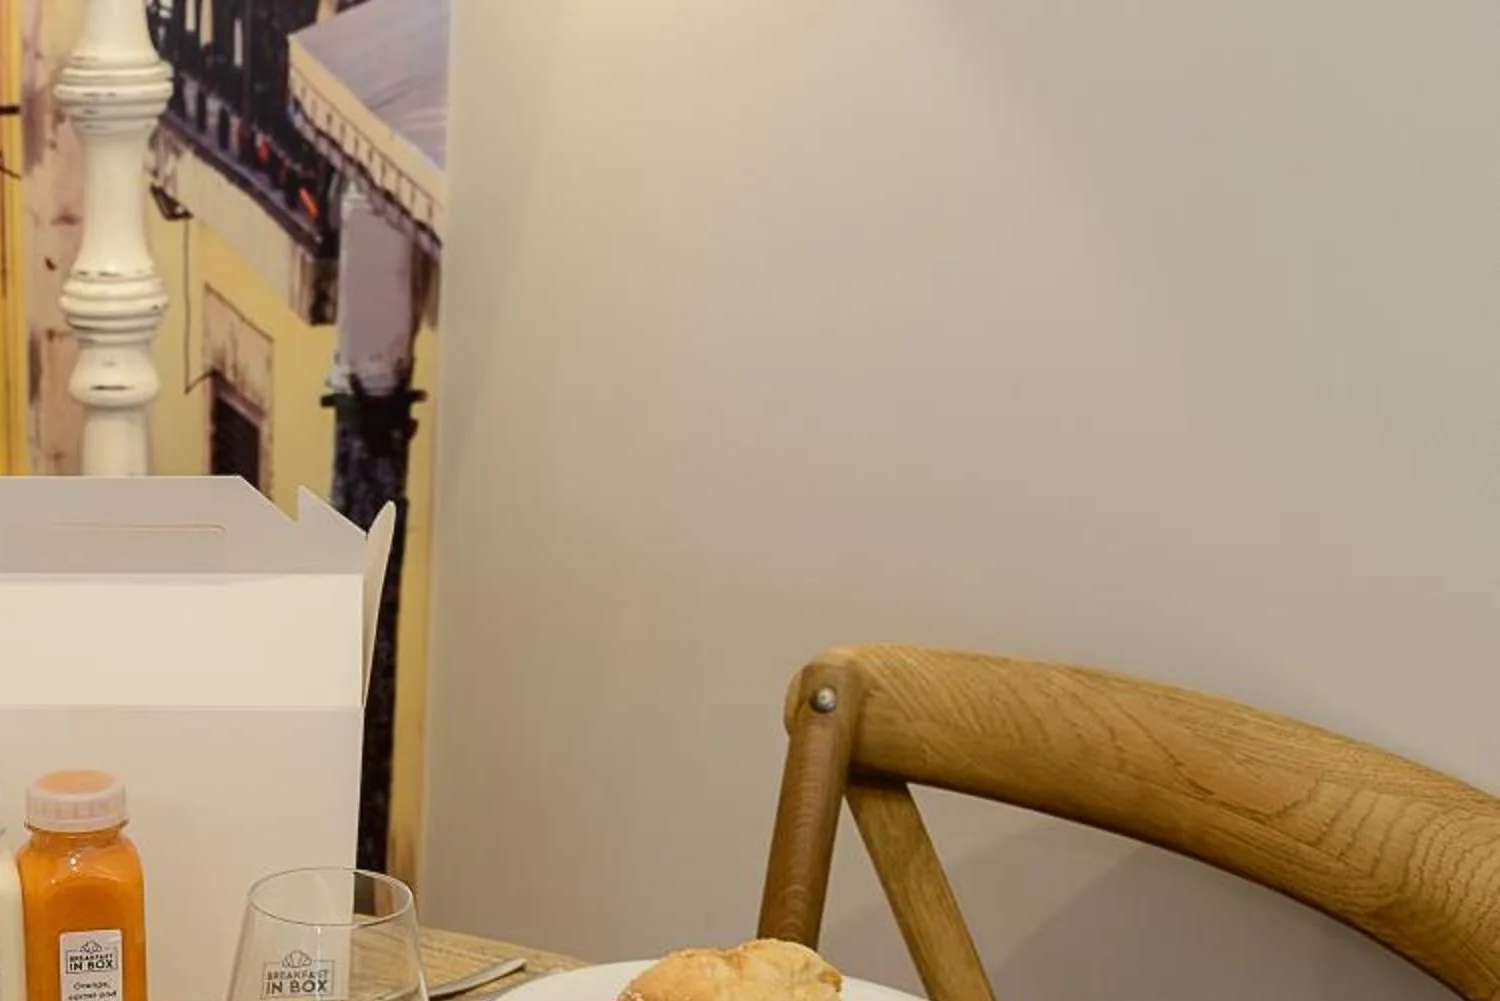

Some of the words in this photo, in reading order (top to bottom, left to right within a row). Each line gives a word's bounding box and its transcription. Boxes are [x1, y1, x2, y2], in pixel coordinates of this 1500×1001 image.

[69, 961, 83, 971] IN
[87, 960, 113, 969] BOX
[267, 969, 329, 979] BREAKFAST
[265, 981, 283, 994] IN
[289, 979, 328, 993] BOX
